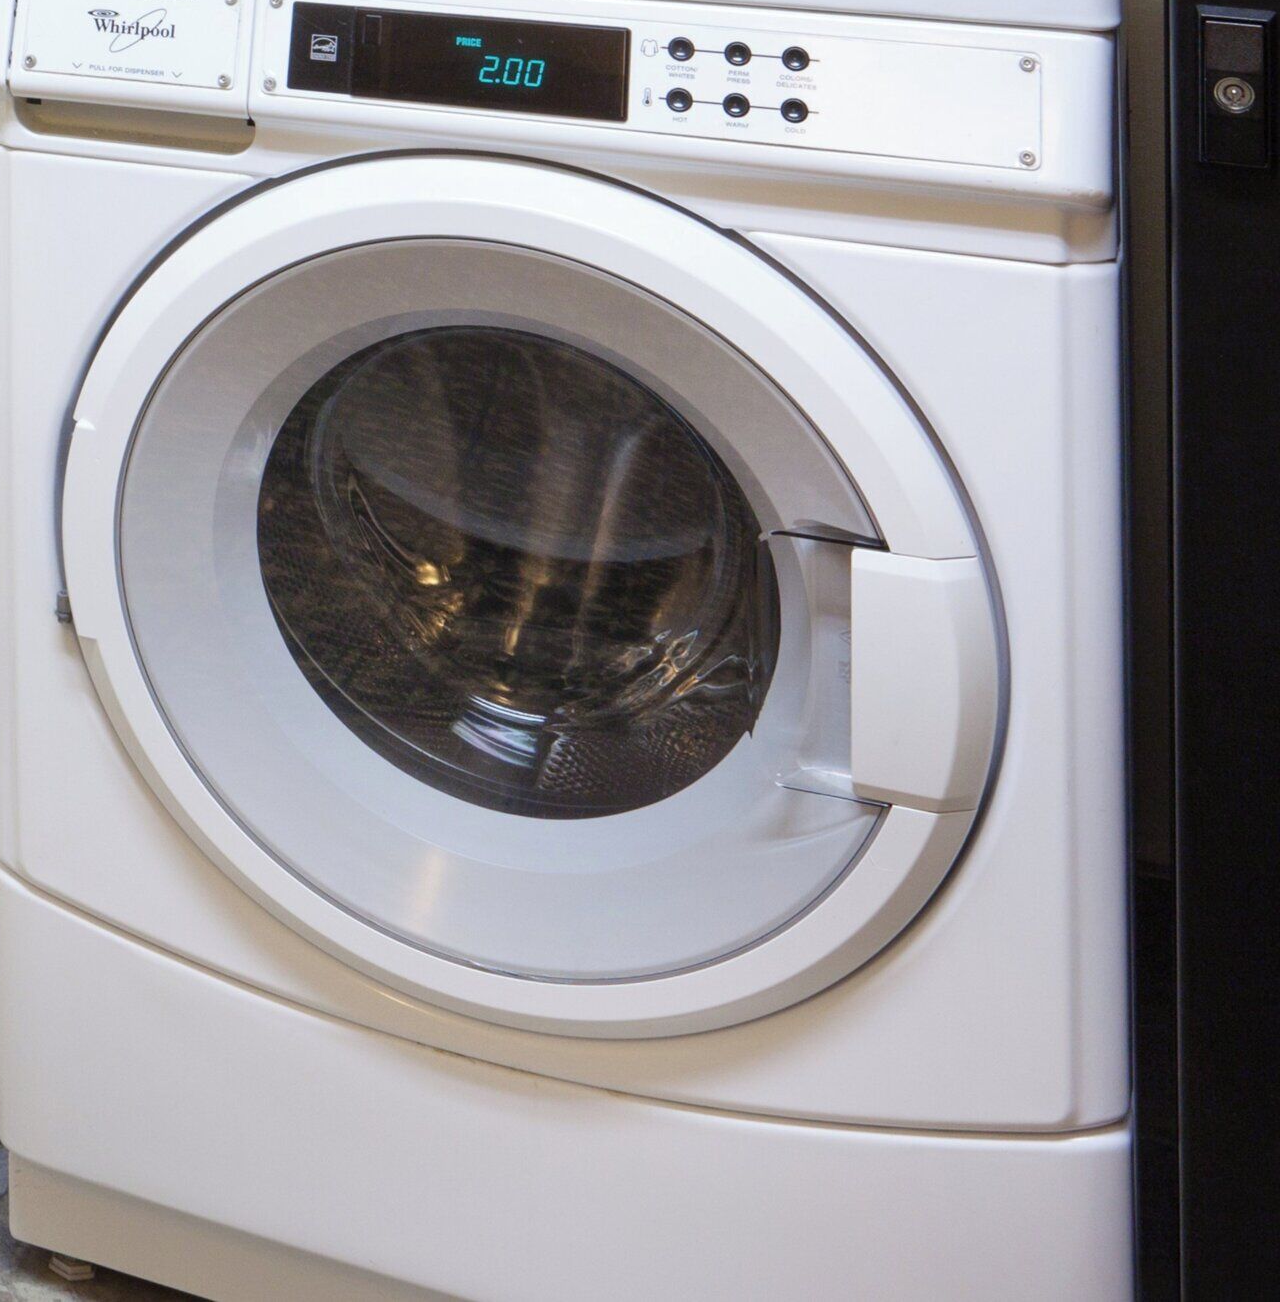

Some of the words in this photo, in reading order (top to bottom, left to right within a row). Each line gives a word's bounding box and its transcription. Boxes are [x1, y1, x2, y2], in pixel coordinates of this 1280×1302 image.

[93, 17, 176, 40] Whirlpool
[455, 36, 482, 48] PRICE
[89, 64, 106, 72] PULL
[108, 65, 123, 73] FOR
[124, 66, 165, 77] DISPENSER
[478, 55, 545, 87] 2.00
[726, 77, 751, 85] PRESS
